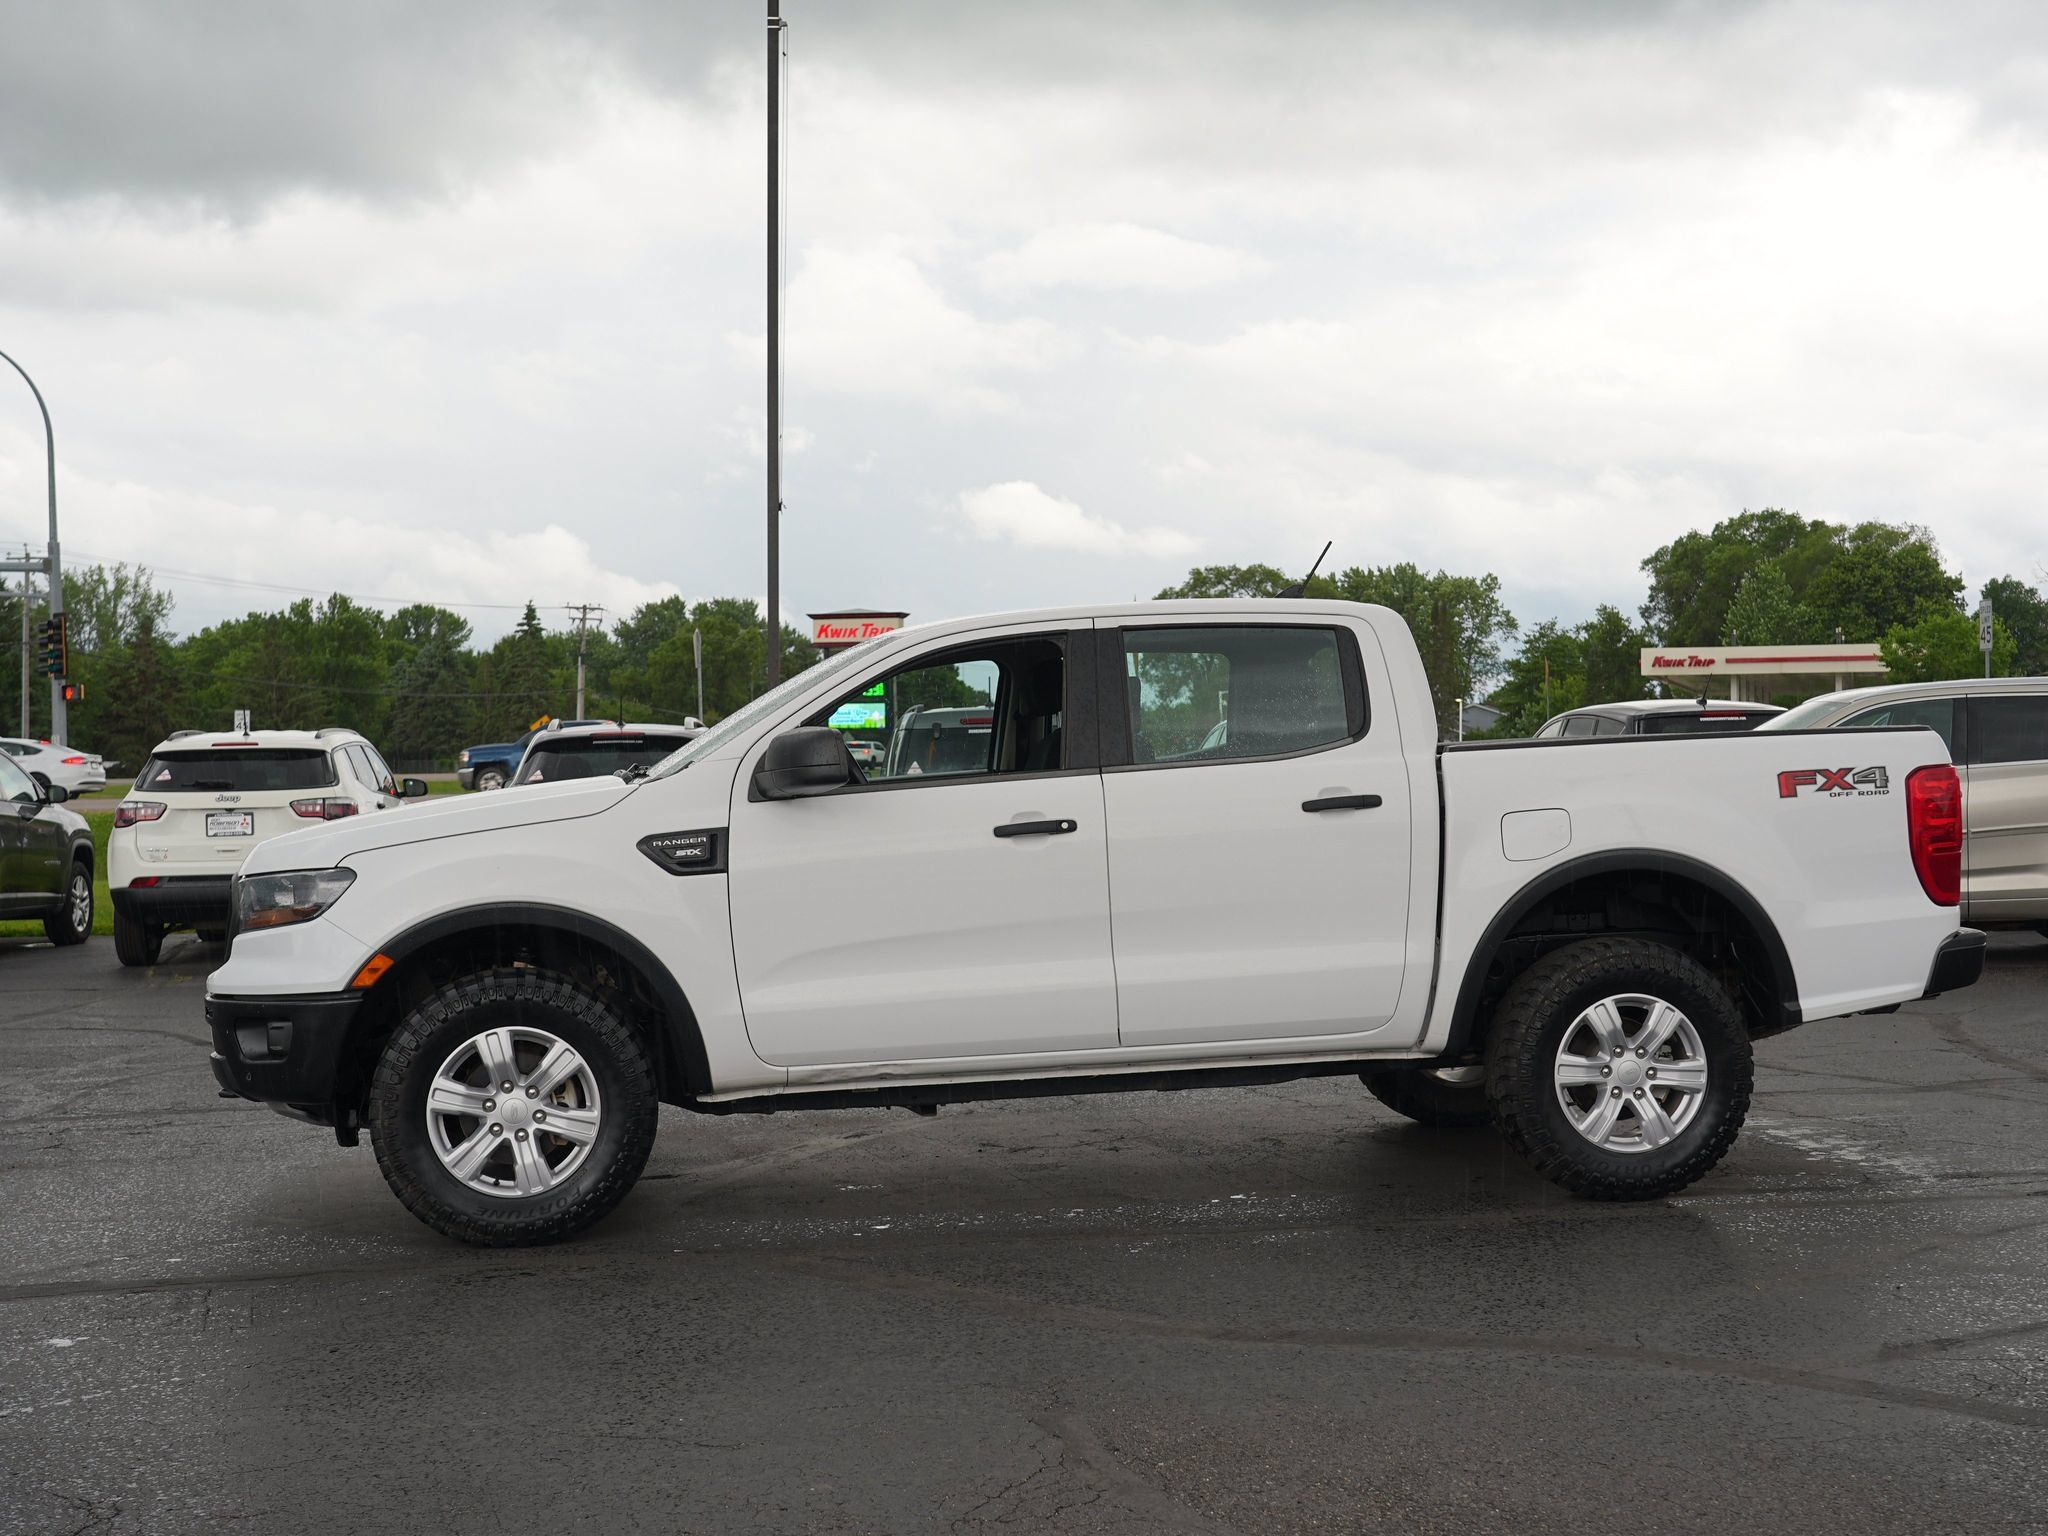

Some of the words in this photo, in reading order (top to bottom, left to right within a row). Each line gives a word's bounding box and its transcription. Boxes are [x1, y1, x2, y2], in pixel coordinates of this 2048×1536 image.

[817, 624, 860, 639] KWIK
[1981, 625, 1992, 644] 45
[1652, 656, 1686, 667] KWIK
[1688, 656, 1716, 667] TRIP
[1777, 765, 1889, 798] FX4
[215, 794, 241, 803] Jeep
[1858, 789, 1889, 797] ROAD
[652, 837, 707, 847] RANGER
[674, 848, 702, 857] STX
[474, 1187, 583, 1220] FORTUNE
